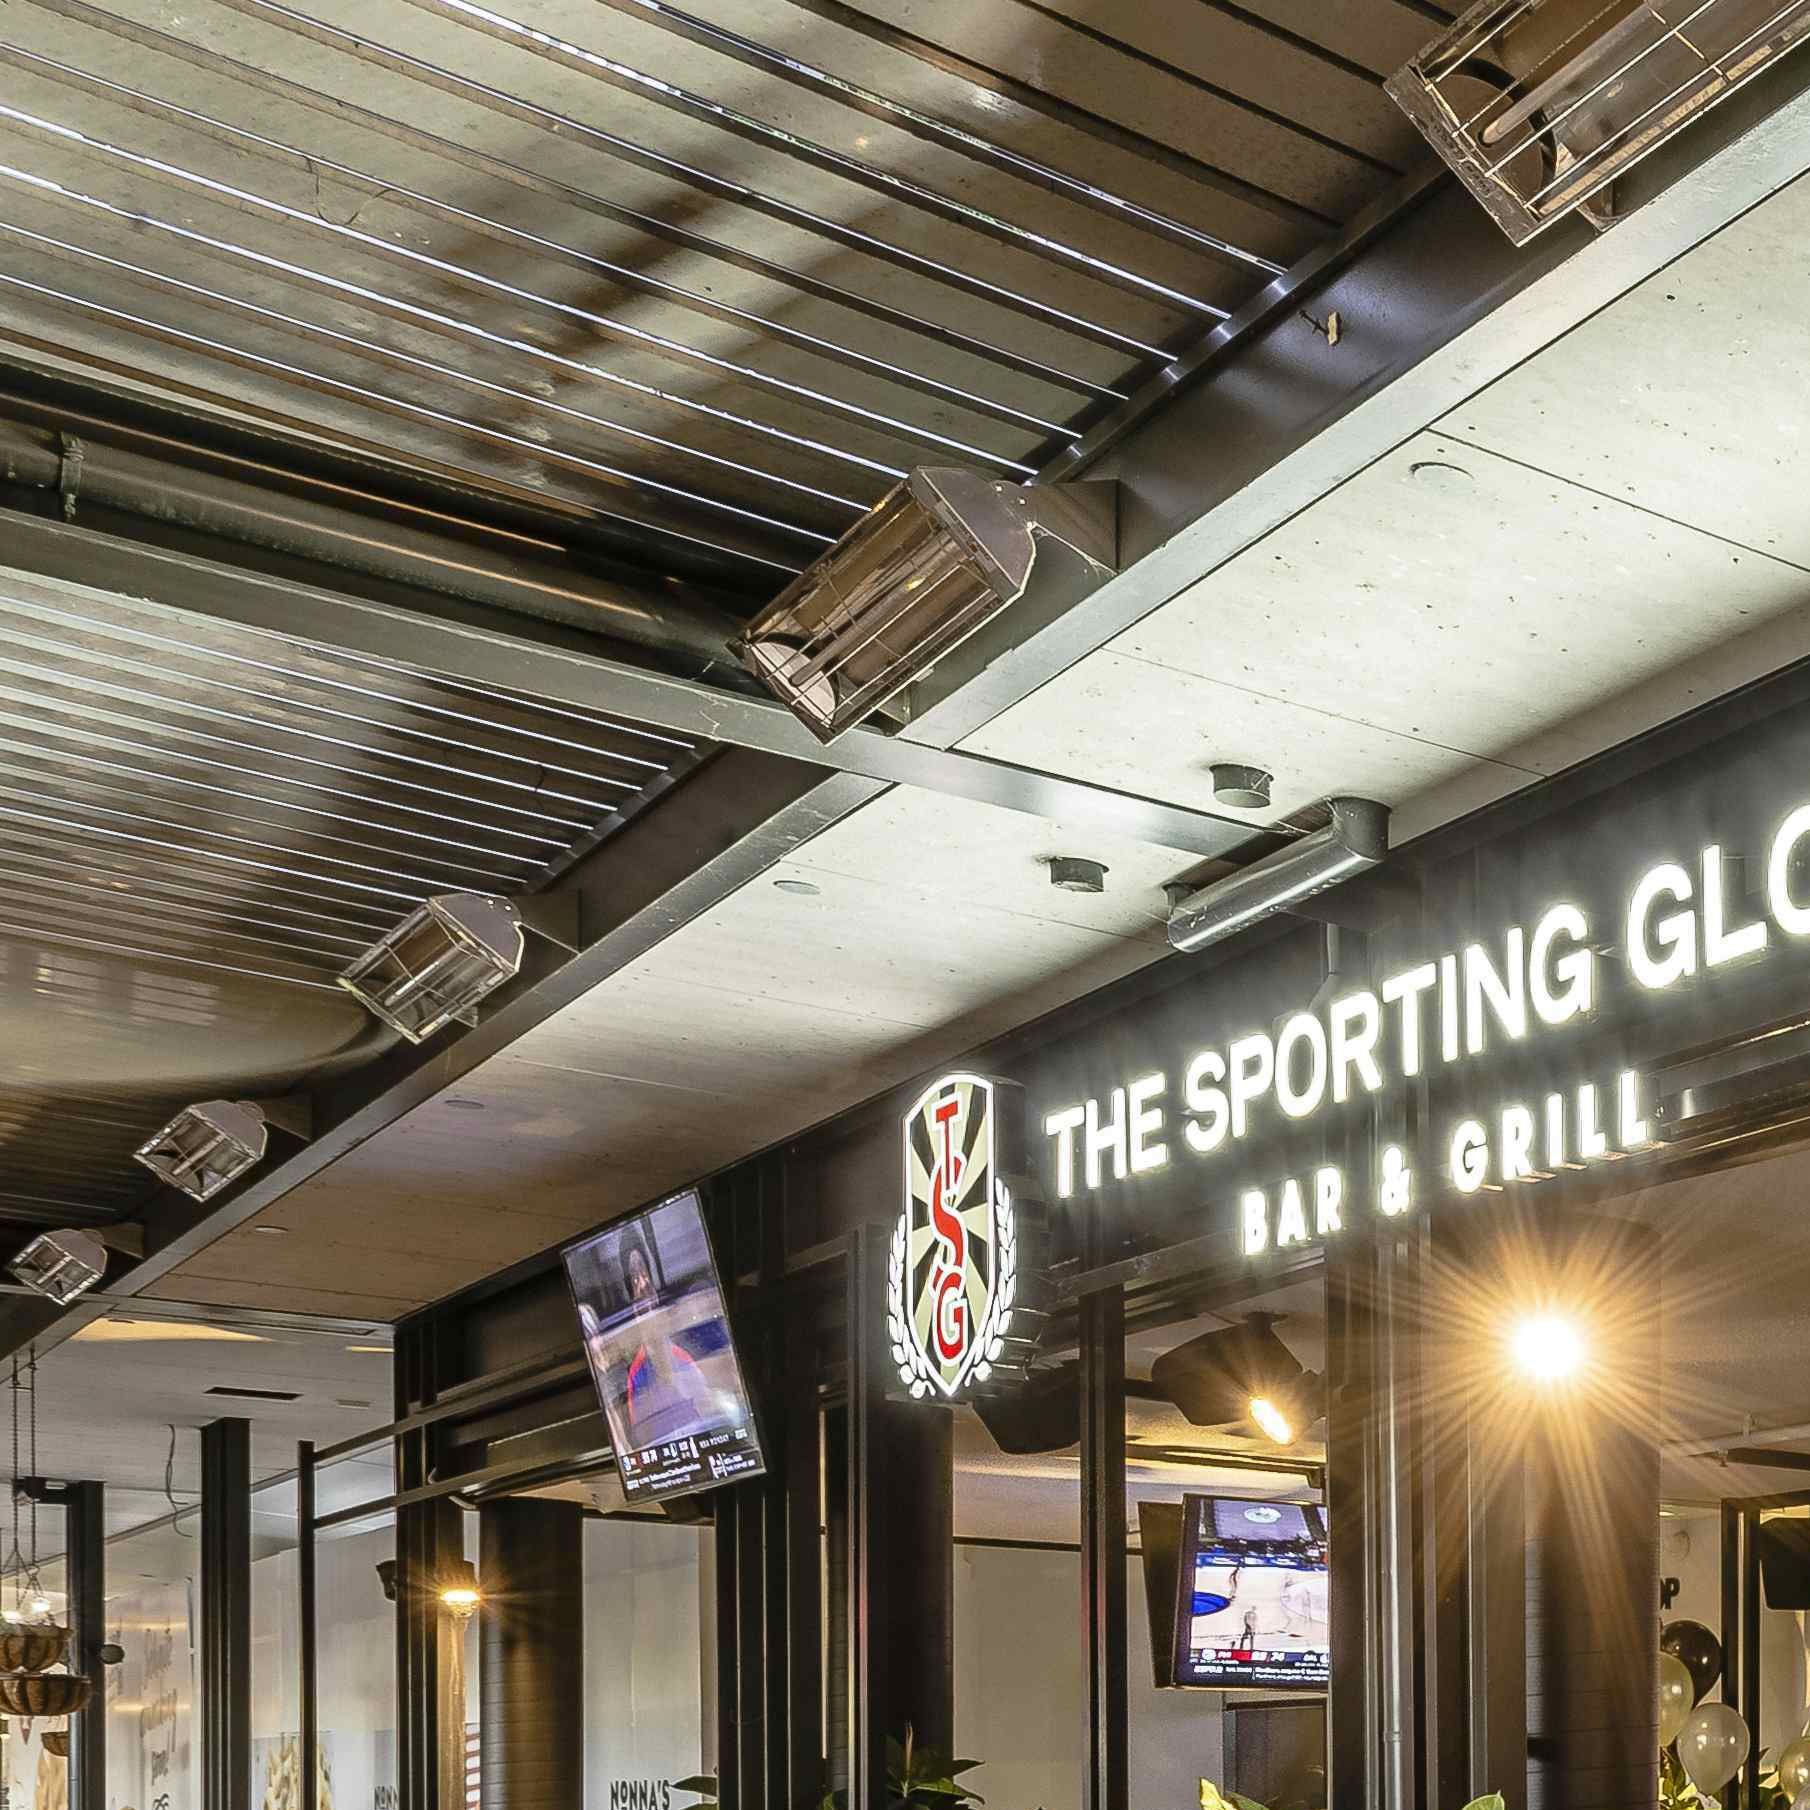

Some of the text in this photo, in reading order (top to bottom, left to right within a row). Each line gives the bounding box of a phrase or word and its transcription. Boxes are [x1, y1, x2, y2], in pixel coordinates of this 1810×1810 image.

[1046, 1072, 1168, 1198] THE
[1185, 902, 1592, 1152] SPORTING
[1243, 1070, 1652, 1255] BAR & GRILL
